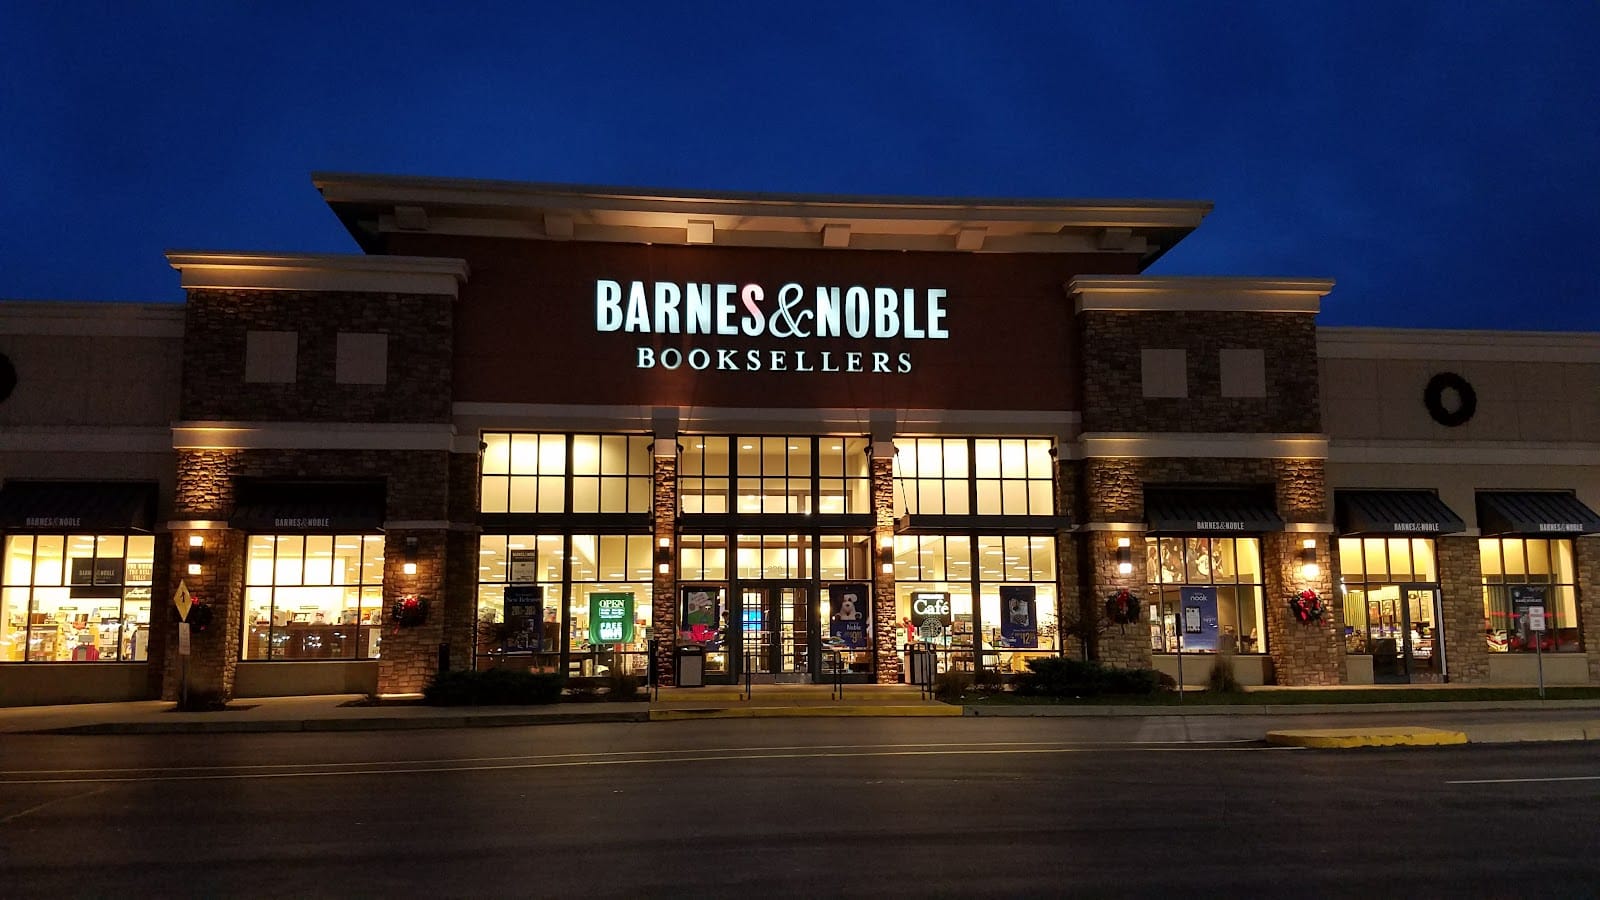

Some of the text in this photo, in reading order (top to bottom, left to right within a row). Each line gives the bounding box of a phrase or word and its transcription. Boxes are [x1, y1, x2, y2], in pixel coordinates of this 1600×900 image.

[636, 346, 913, 374] BOOKSELLERS
[598, 599, 625, 608] OPEN
[1190, 594, 1208, 602] nook
[913, 599, 950, 615] Café
